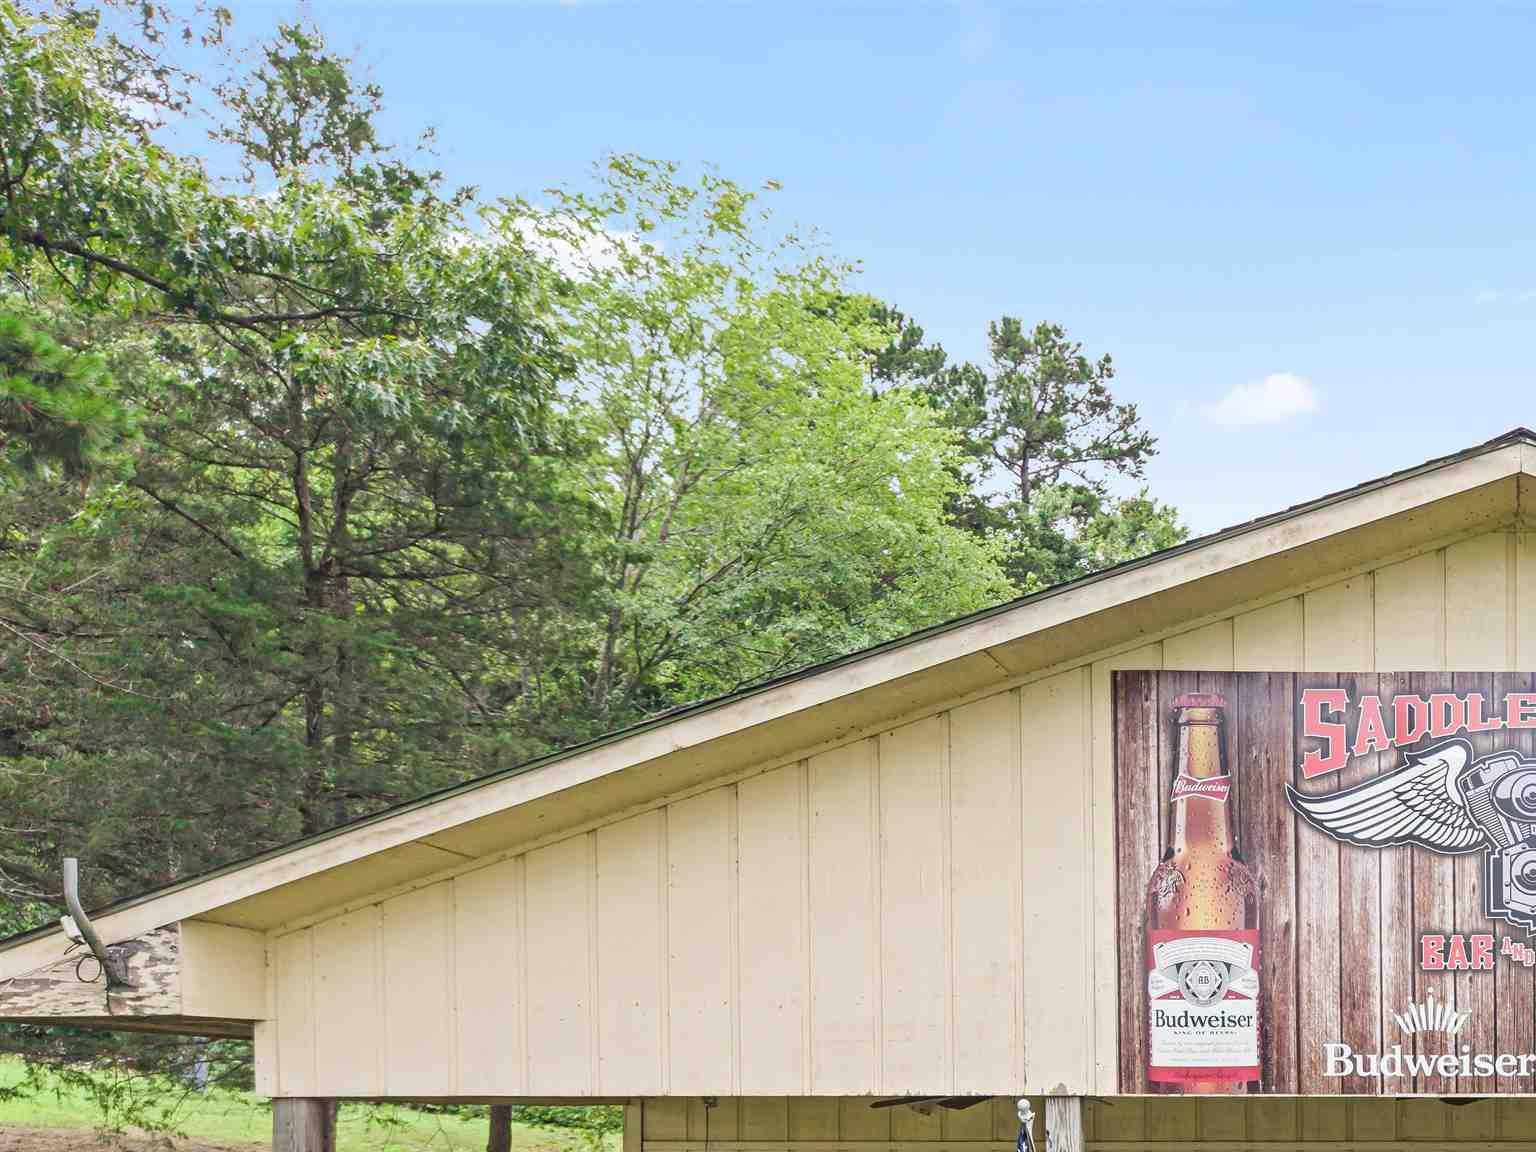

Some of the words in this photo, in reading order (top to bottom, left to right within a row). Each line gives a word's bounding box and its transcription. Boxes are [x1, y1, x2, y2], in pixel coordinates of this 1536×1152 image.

[1421, 934, 1495, 970] BAR
[1500, 936, 1535, 967] AND
[1155, 1009, 1253, 1028] Budweiser
[1323, 1043, 1536, 1077] Budweiser
